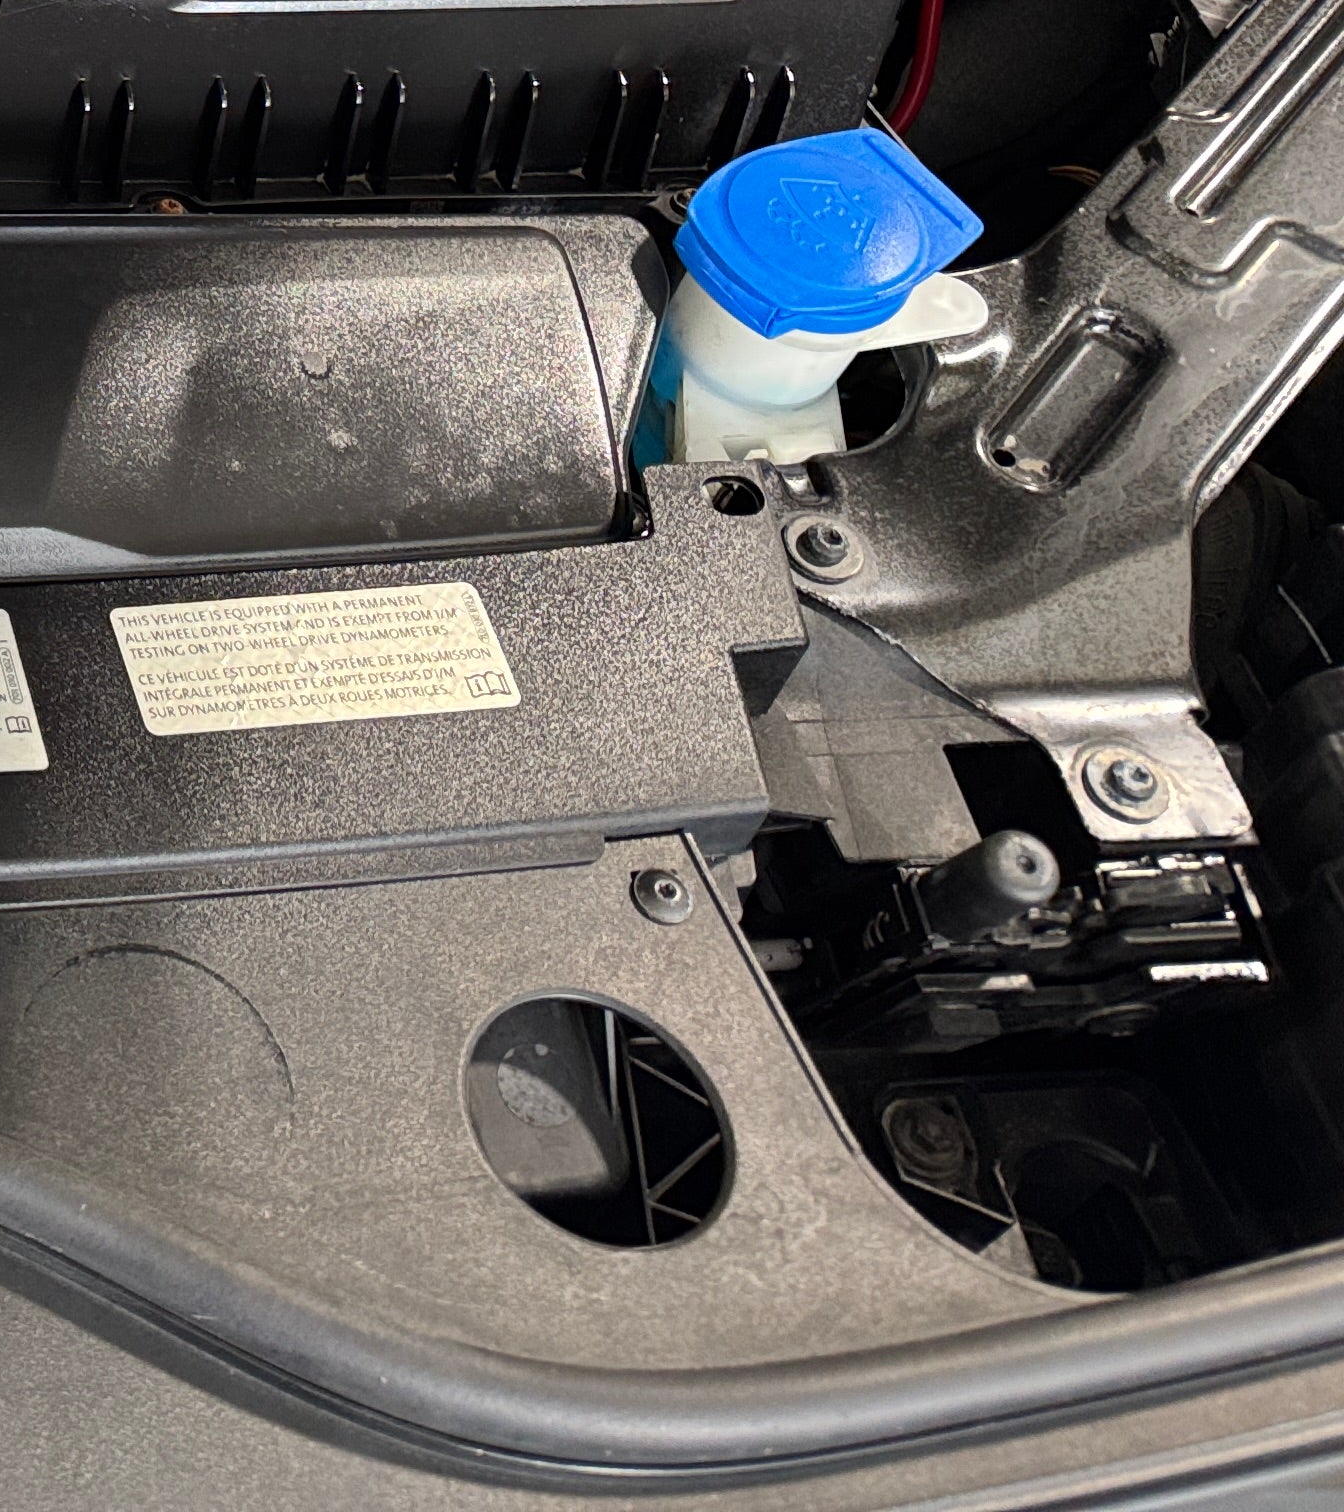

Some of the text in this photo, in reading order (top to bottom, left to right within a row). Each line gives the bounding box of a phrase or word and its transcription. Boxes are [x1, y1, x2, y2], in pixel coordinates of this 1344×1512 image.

[118, 595, 423, 628] THIS VEHICLE IS EQUIPPED WITH A PERMANENT
[126, 628, 199, 643] ALL-WHEEL
[201, 624, 241, 638] DRIVE
[243, 620, 293, 634] SYSTEM
[328, 616, 341, 628] IS
[342, 612, 392, 627] EXEMPT
[394, 609, 433, 623] FROM
[130, 644, 185, 659] TESTING
[188, 643, 210, 655] ON
[211, 637, 297, 653] TWO-WHEEL
[298, 632, 339, 647] DRIVE
[138, 674, 155, 686] CE
[223, 666, 245, 679] EST
[378, 654, 395, 667] DE
[395, 647, 492, 665] TRANSMISSION
[148, 705, 177, 719] SUR
[300, 692, 337, 706] DEUX
[338, 688, 383, 704] ROUES
[213, 679, 291, 697] PERMANENT
[293, 678, 309, 690] ET
